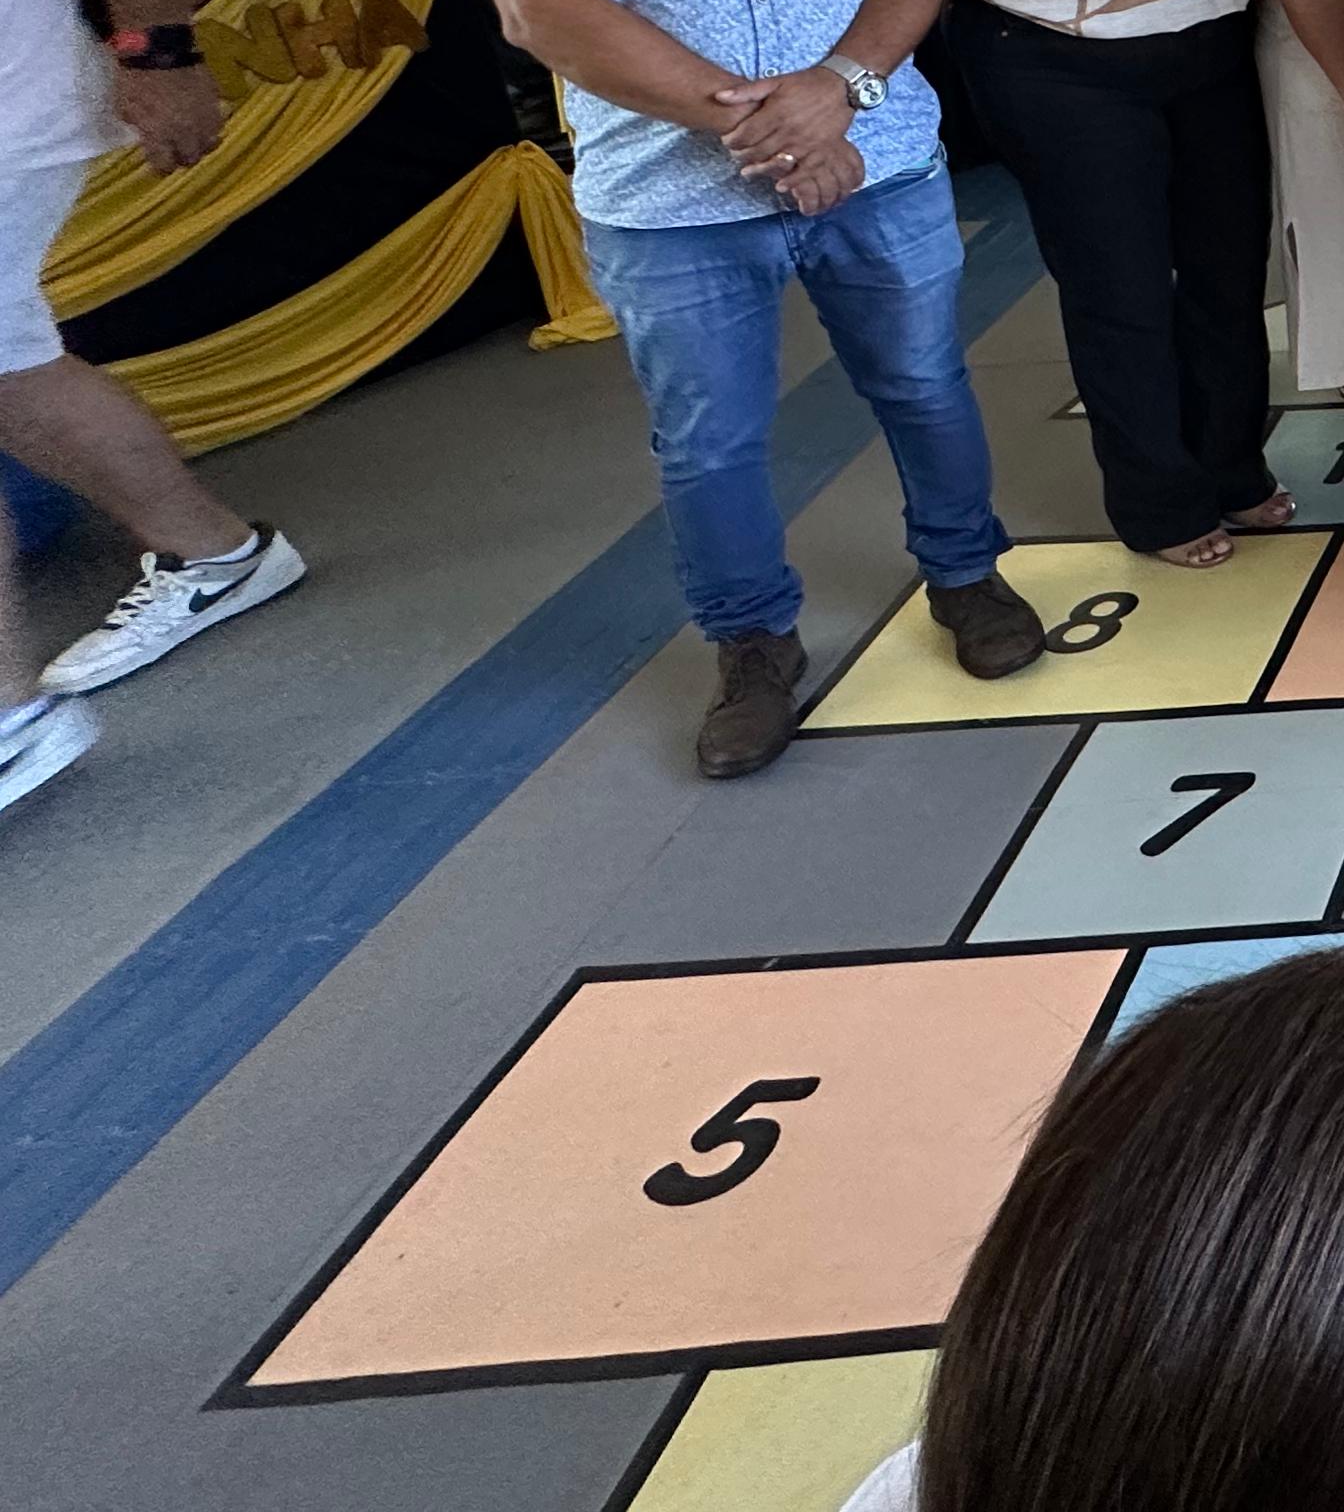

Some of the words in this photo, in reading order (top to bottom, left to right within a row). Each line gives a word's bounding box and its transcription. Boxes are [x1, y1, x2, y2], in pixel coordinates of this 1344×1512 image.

[1043, 591, 1140, 655] 8
[1139, 771, 1257, 858] 7
[642, 1075, 822, 1208] 5
